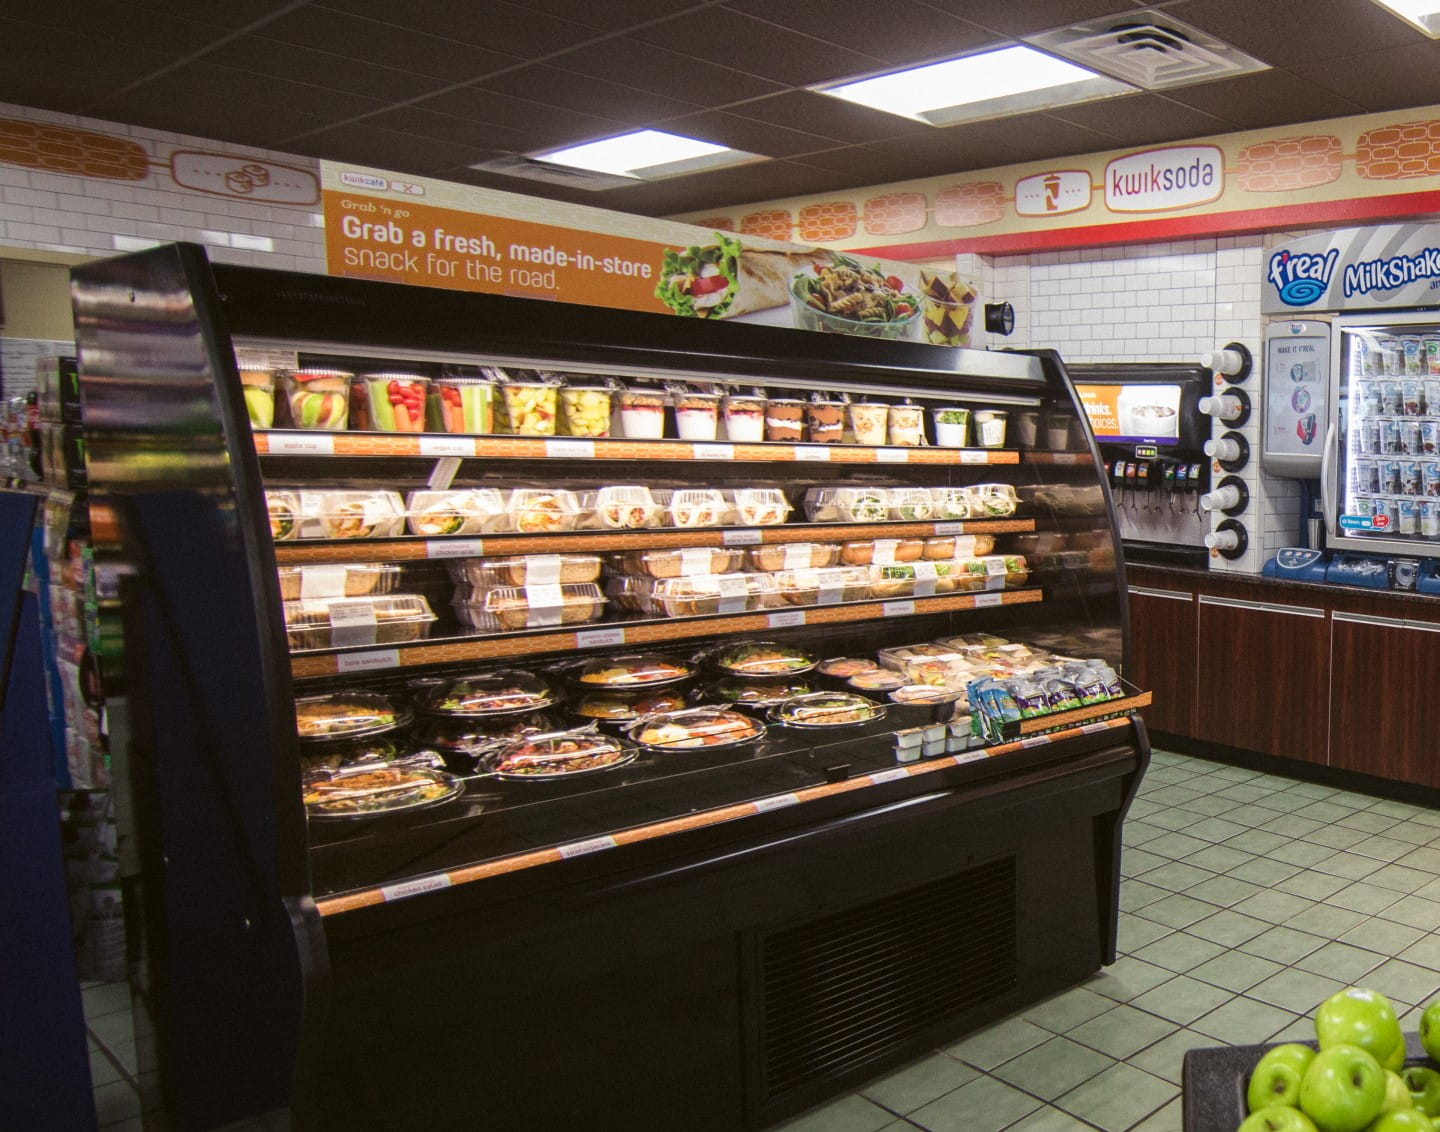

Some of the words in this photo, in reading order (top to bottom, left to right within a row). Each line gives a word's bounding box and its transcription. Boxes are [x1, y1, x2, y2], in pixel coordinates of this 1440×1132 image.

[343, 174, 385, 187] kwikcafé
[1112, 157, 1214, 197] kwiksoda
[341, 200, 377, 213] Grab
[394, 208, 410, 218] go
[342, 215, 404, 245] Grab
[411, 229, 426, 248] a
[434, 228, 501, 262] fresh,
[509, 243, 652, 279] made-in-store
[344, 247, 419, 273] snack
[427, 253, 459, 278] for
[466, 258, 502, 283] the
[509, 269, 560, 290] road.
[1269, 249, 1339, 290] f'real
